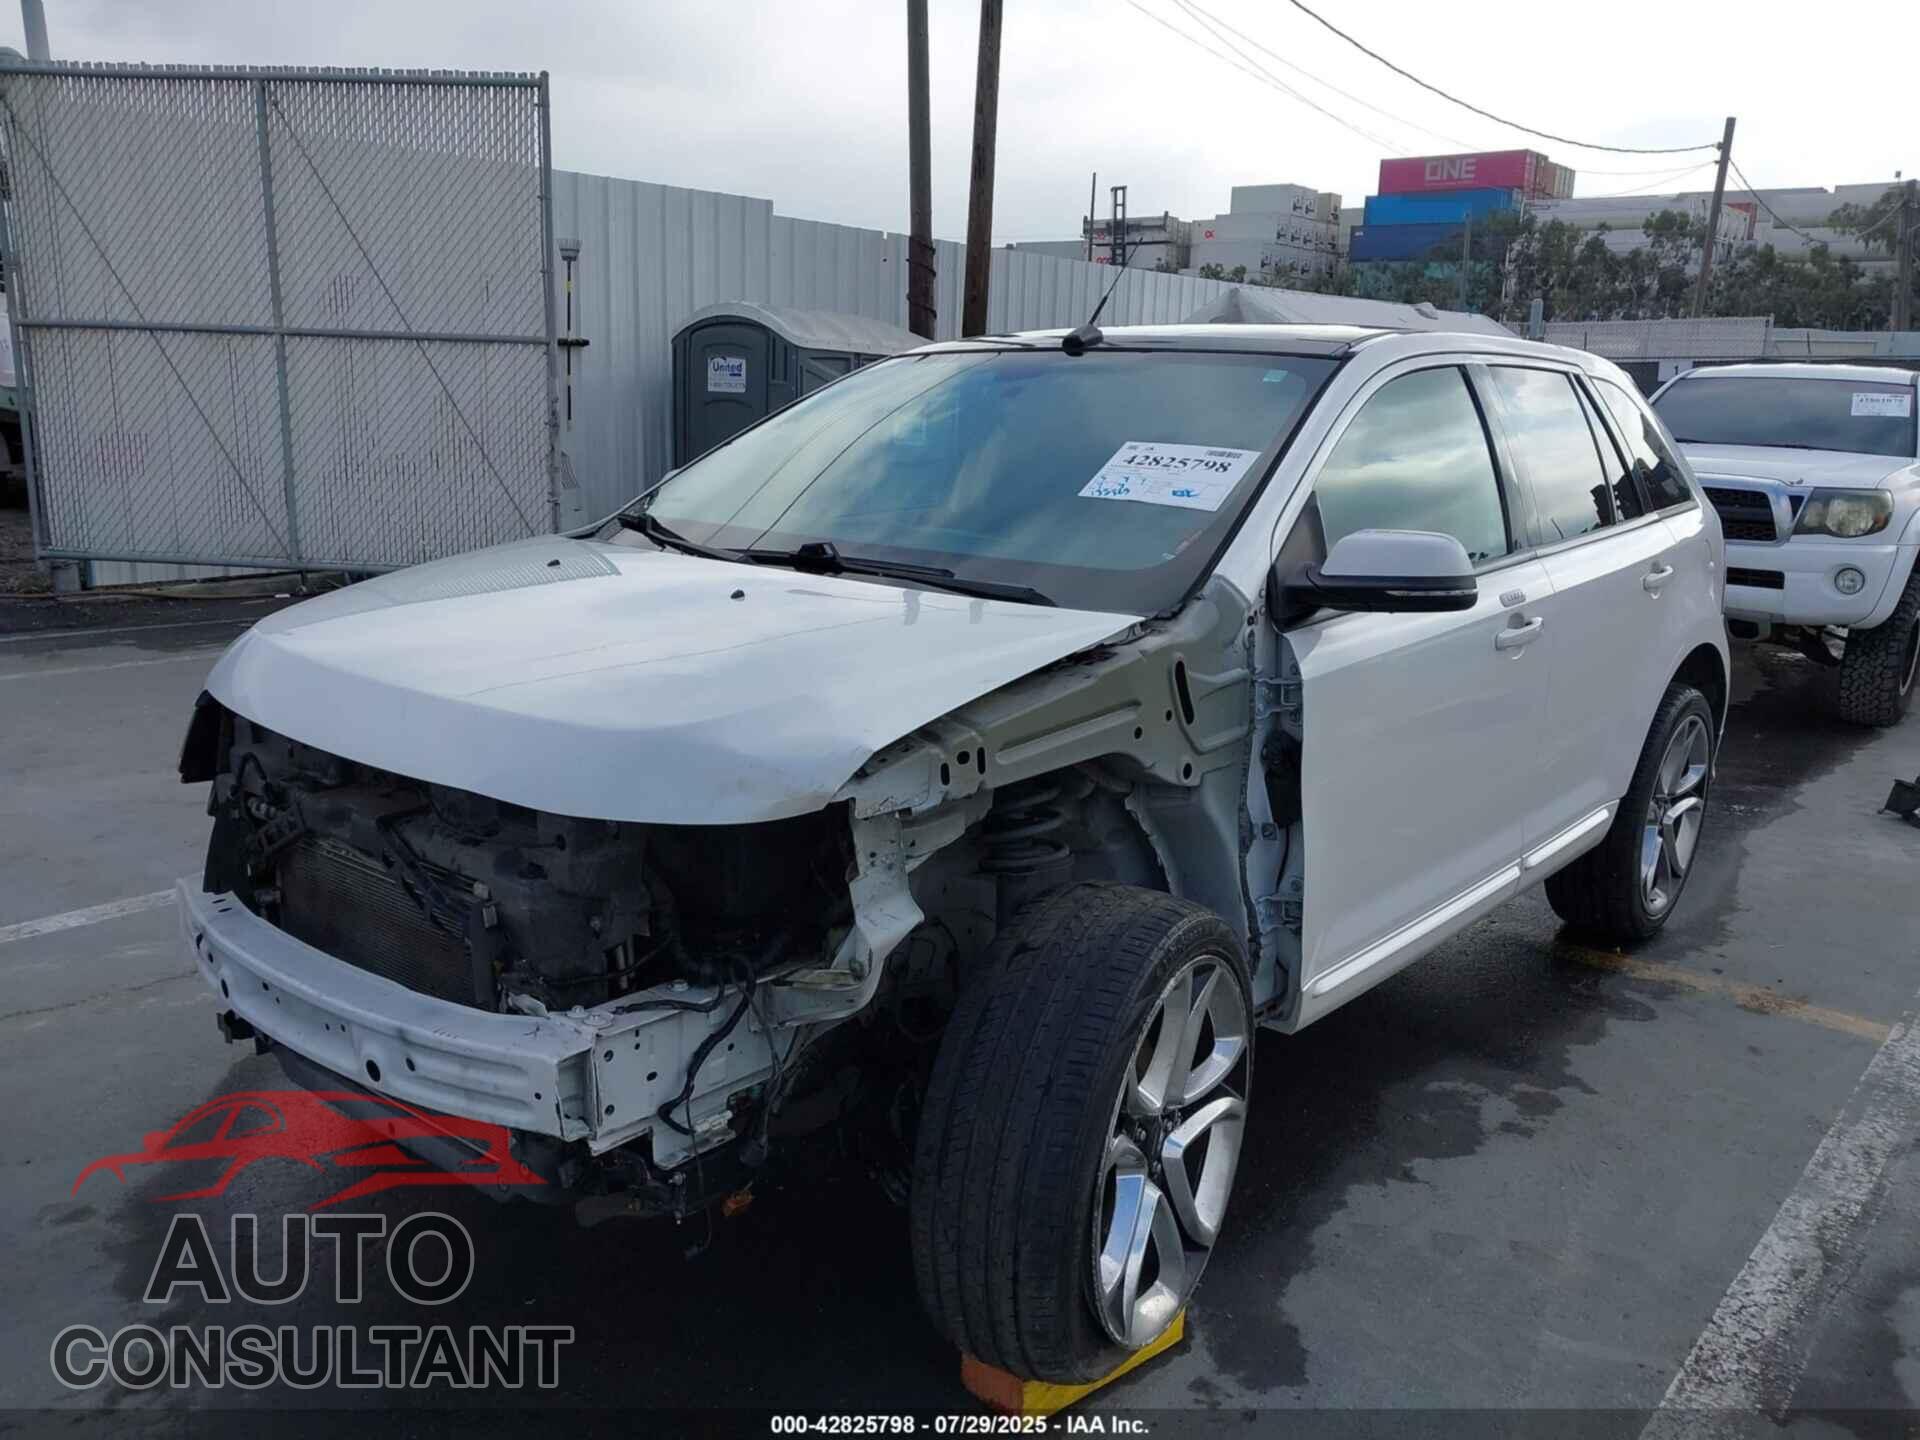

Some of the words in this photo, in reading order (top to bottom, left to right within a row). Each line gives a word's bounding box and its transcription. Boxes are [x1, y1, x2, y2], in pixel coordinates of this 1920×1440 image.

[1424, 158, 1478, 181] ONE
[712, 361, 743, 373] United
[1122, 454, 1232, 474] 42825798
